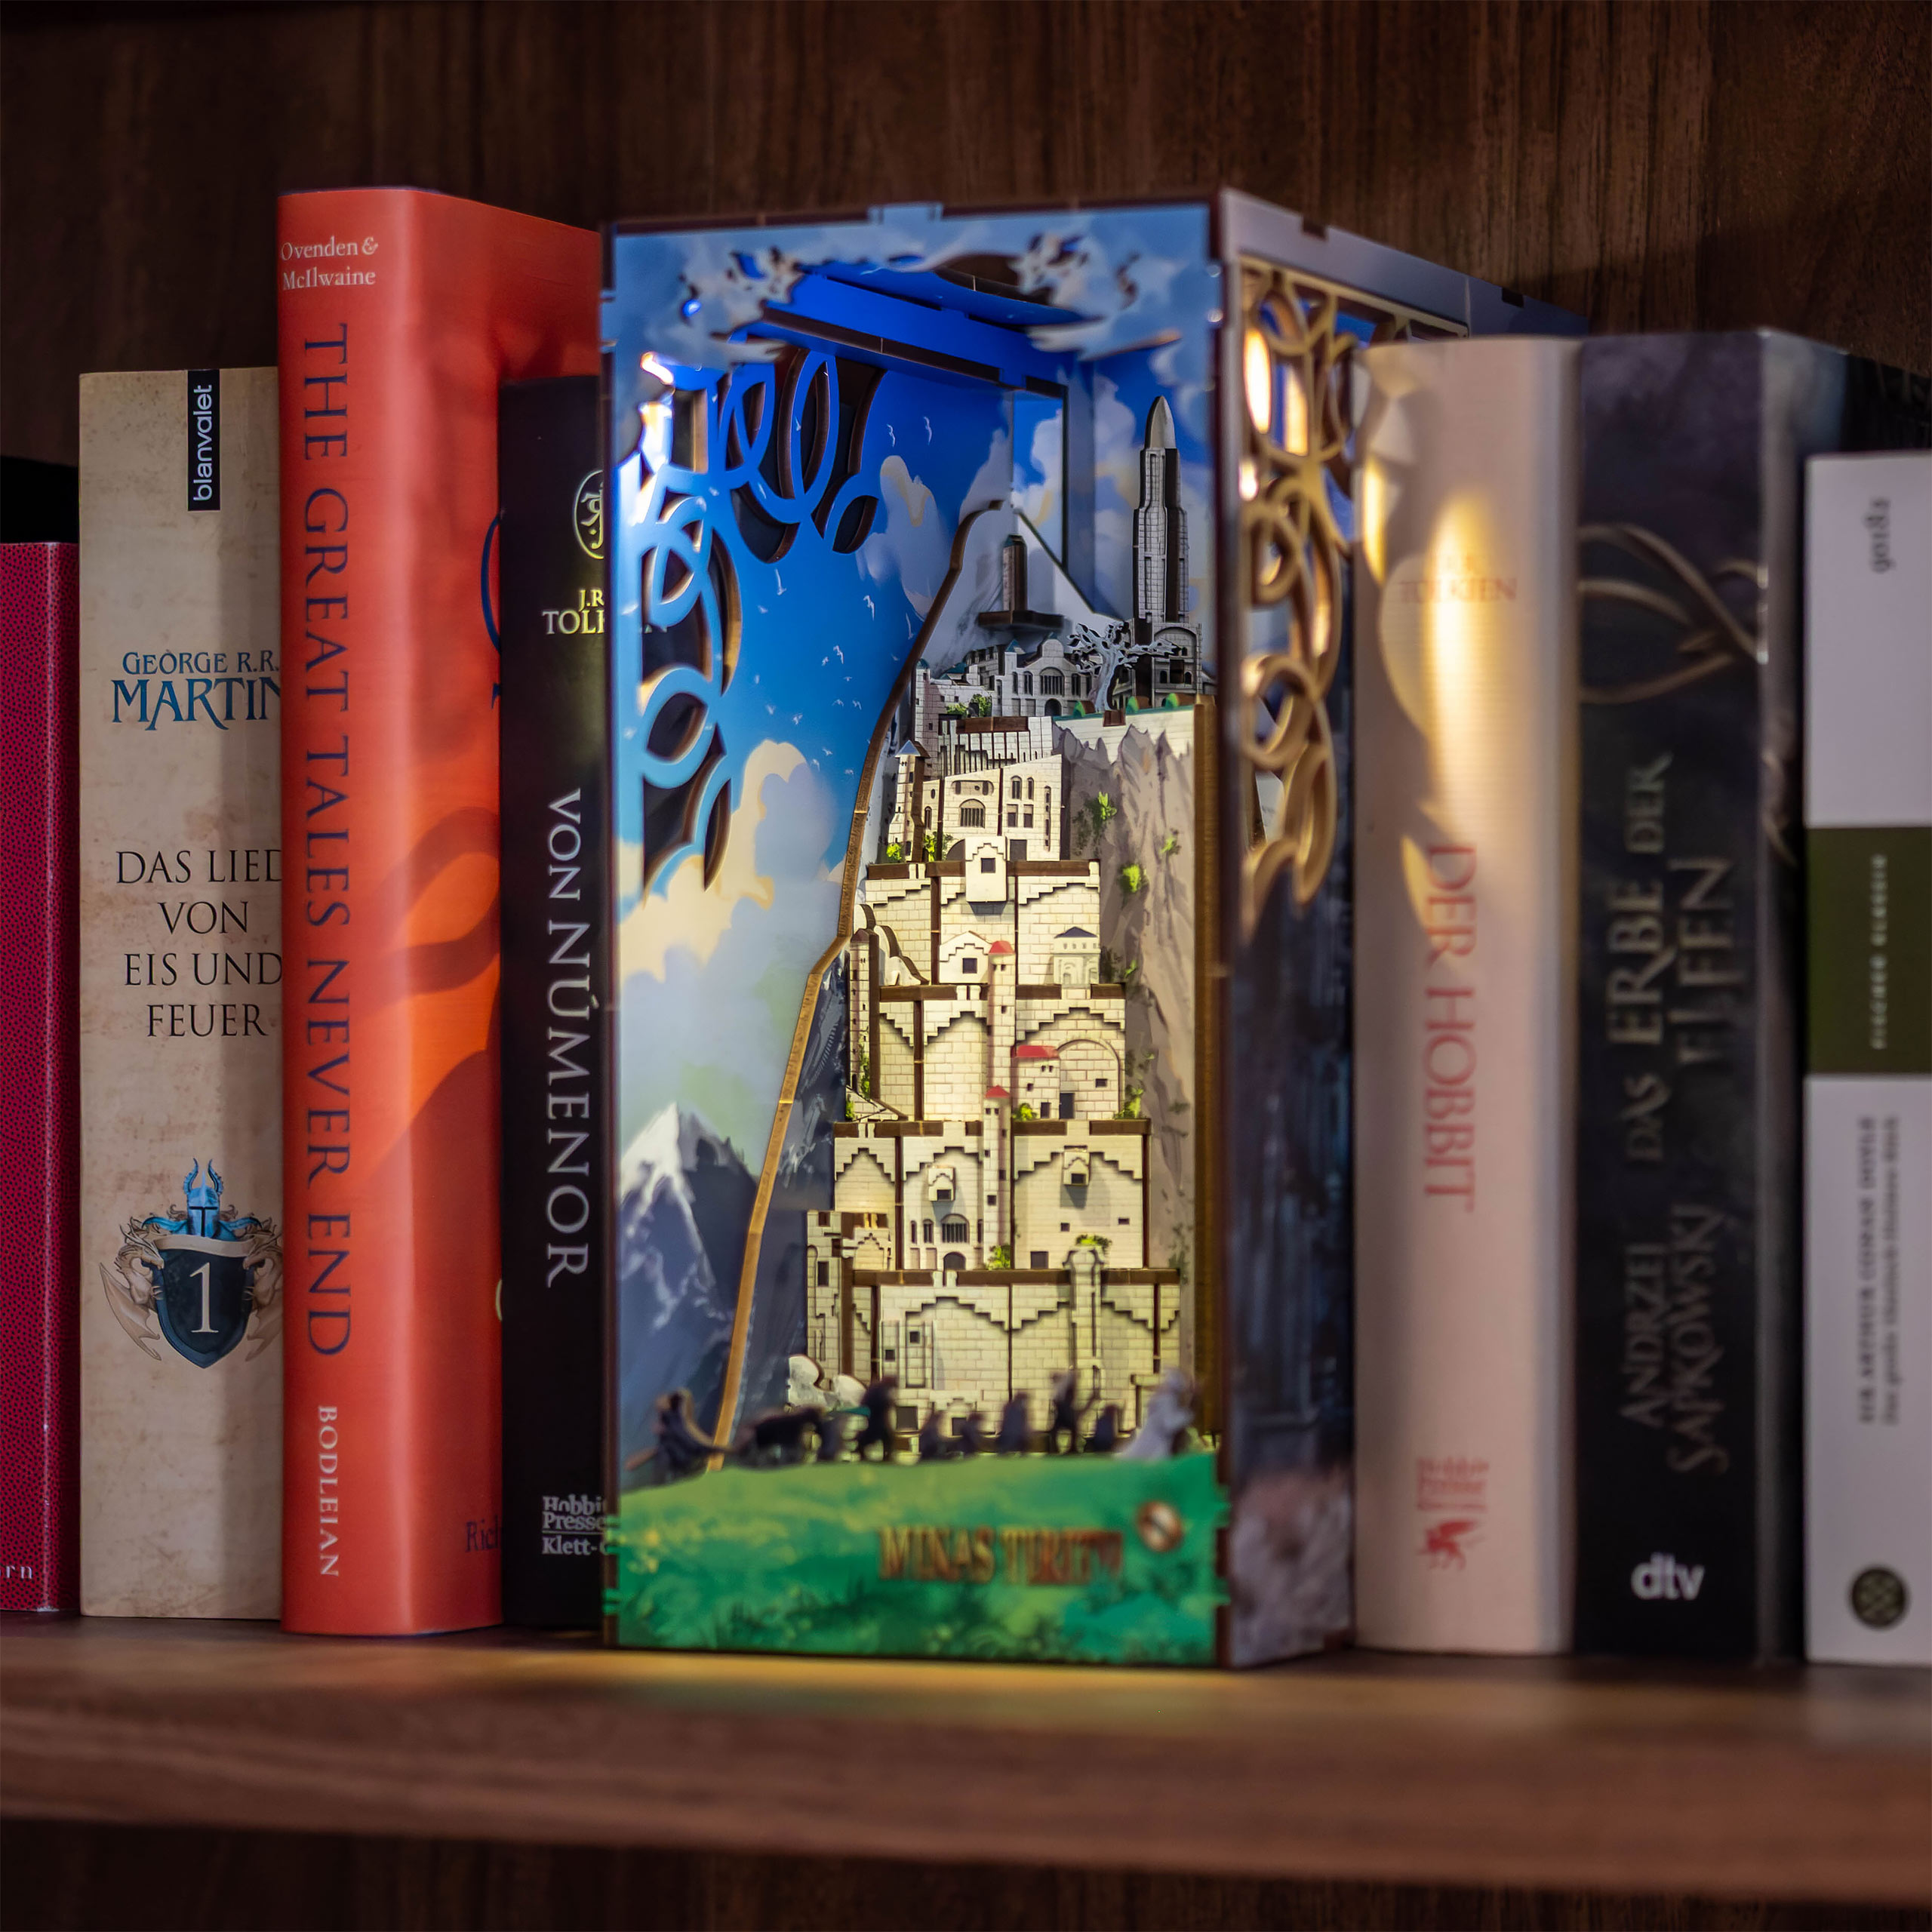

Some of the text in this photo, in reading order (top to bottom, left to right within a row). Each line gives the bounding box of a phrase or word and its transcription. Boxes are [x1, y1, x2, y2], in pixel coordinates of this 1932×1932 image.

[280, 235, 379, 261] Ovenden &
[282, 266, 377, 291] McIlwaine
[192, 384, 213, 501] blanvalet
[122, 650, 280, 675] GEORGE R.R.
[1623, 751, 1674, 854] DER
[304, 322, 352, 1357] THE GREAT TALES NEVER END
[115, 850, 192, 884] DAS
[157, 900, 248, 934] VON
[124, 952, 283, 986] EIS UND
[1606, 880, 1677, 1046] ERBE
[146, 1004, 267, 1038] FEUER
[546, 787, 600, 1289] VON NÚMENOR
[1423, 842, 1478, 1213] DER HOBBIT
[189, 1261, 220, 1334] 1
[317, 1405, 340, 1577] BODLEIAN
[0, 1565, 32, 1580] rn
[1630, 1552, 1706, 1600] dtv
